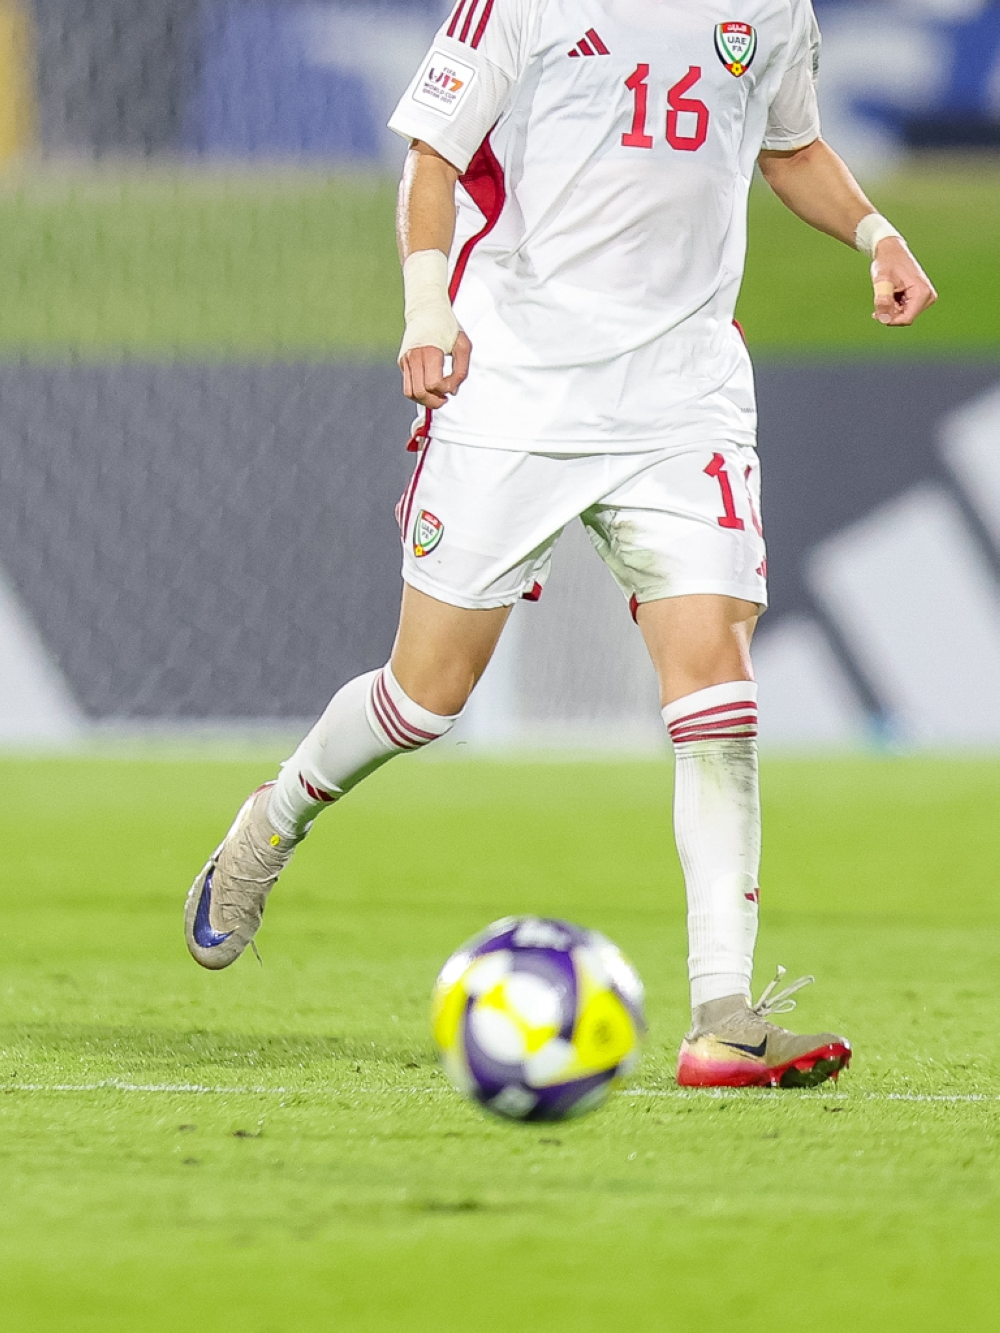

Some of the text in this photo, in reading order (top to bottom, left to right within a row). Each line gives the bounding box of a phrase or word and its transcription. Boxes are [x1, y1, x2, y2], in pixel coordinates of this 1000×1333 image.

[727, 36, 747, 45] UAE
[428, 67, 464, 93] U17
[443, 67, 456, 77] FIFA
[424, 81, 457, 100] WORLD CUP
[621, 63, 709, 151] 16
